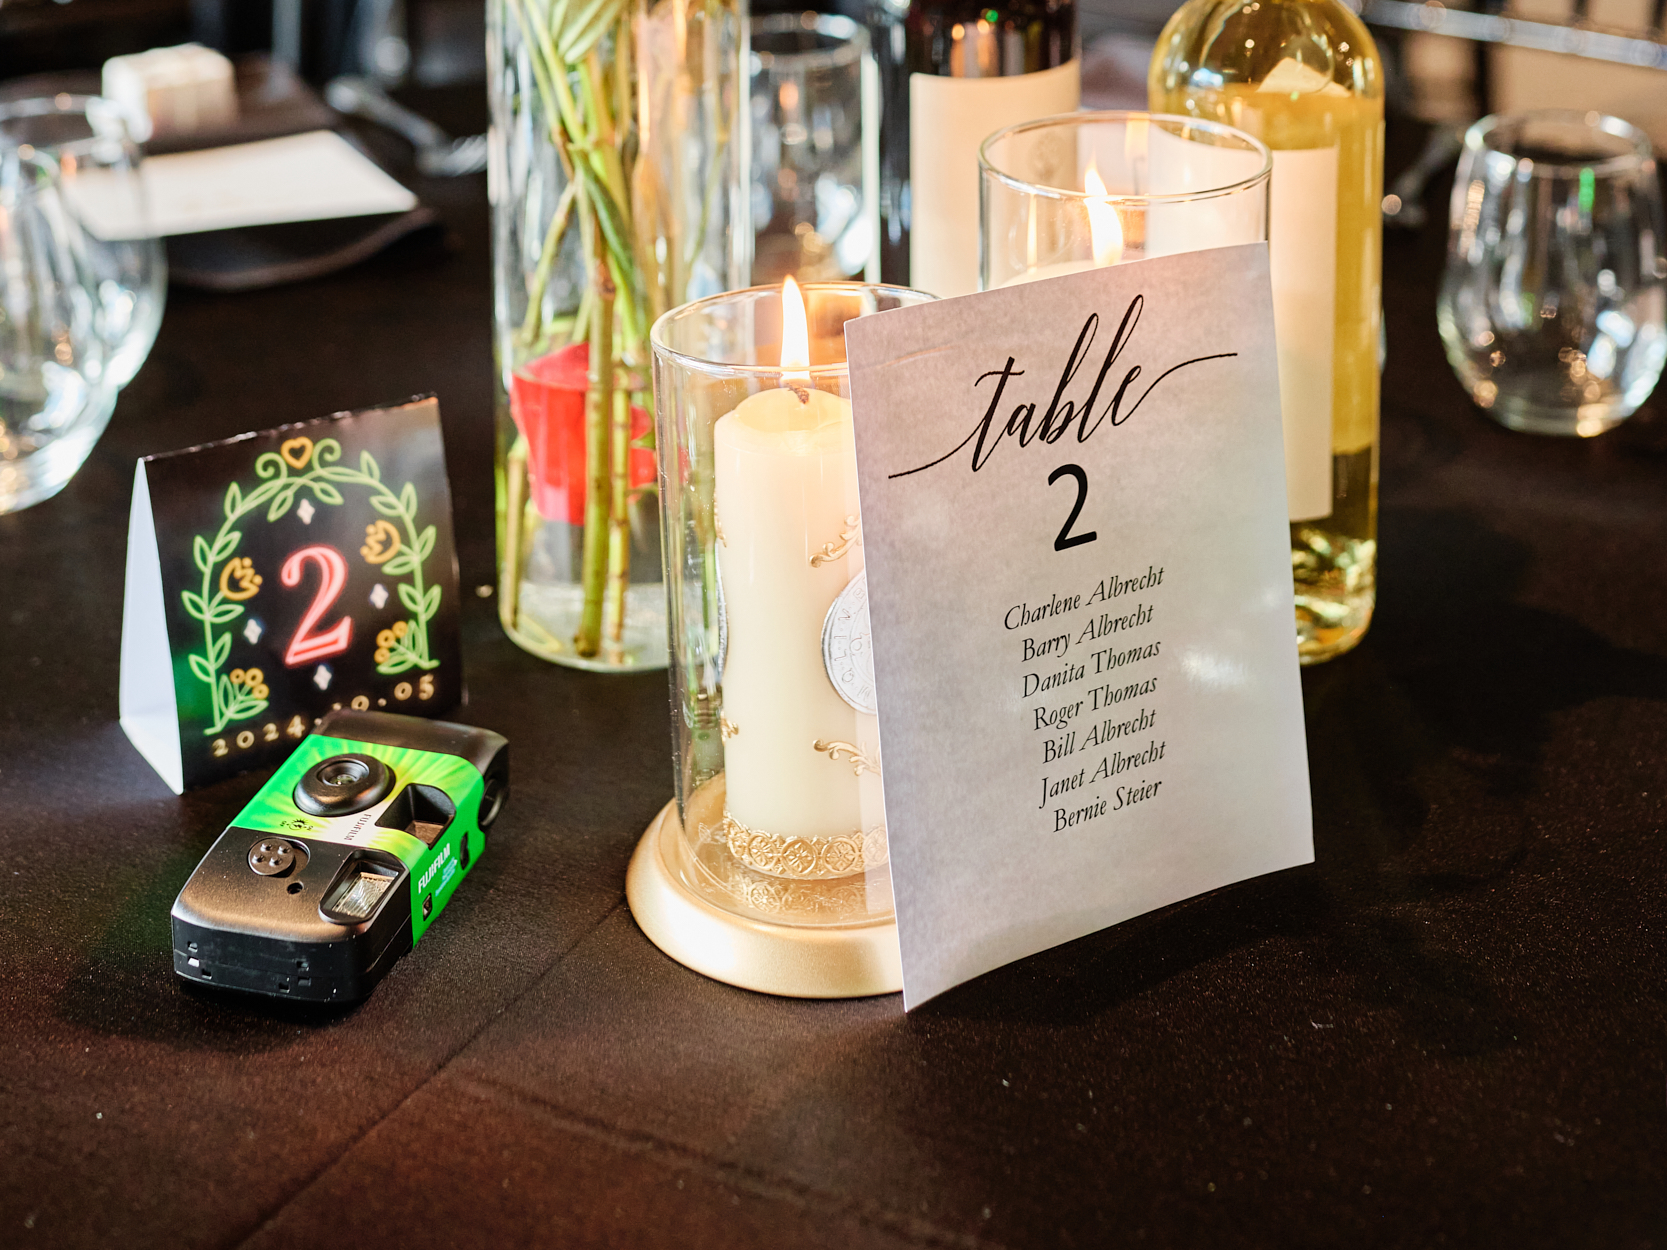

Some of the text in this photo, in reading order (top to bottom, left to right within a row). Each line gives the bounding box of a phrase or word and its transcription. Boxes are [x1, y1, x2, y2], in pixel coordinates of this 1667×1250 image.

[888, 294, 1238, 479] table
[1048, 463, 1097, 551] 2
[281, 545, 353, 666] 2
[1004, 566, 1165, 630] Charlene Albrecht
[1021, 604, 1154, 662] Barry Albrecht
[1022, 641, 1161, 698] Danita Thomas
[212, 673, 434, 757] 2024.0.05
[1033, 677, 1157, 730] Roger Thomas
[1043, 708, 1157, 764] Bill Albrecht
[1039, 741, 1166, 809] Janet Albrecht
[344, 813, 371, 840] FUJIFILM
[1053, 779, 1162, 832] Bernie Steier
[418, 843, 450, 894] FUJIFILM
